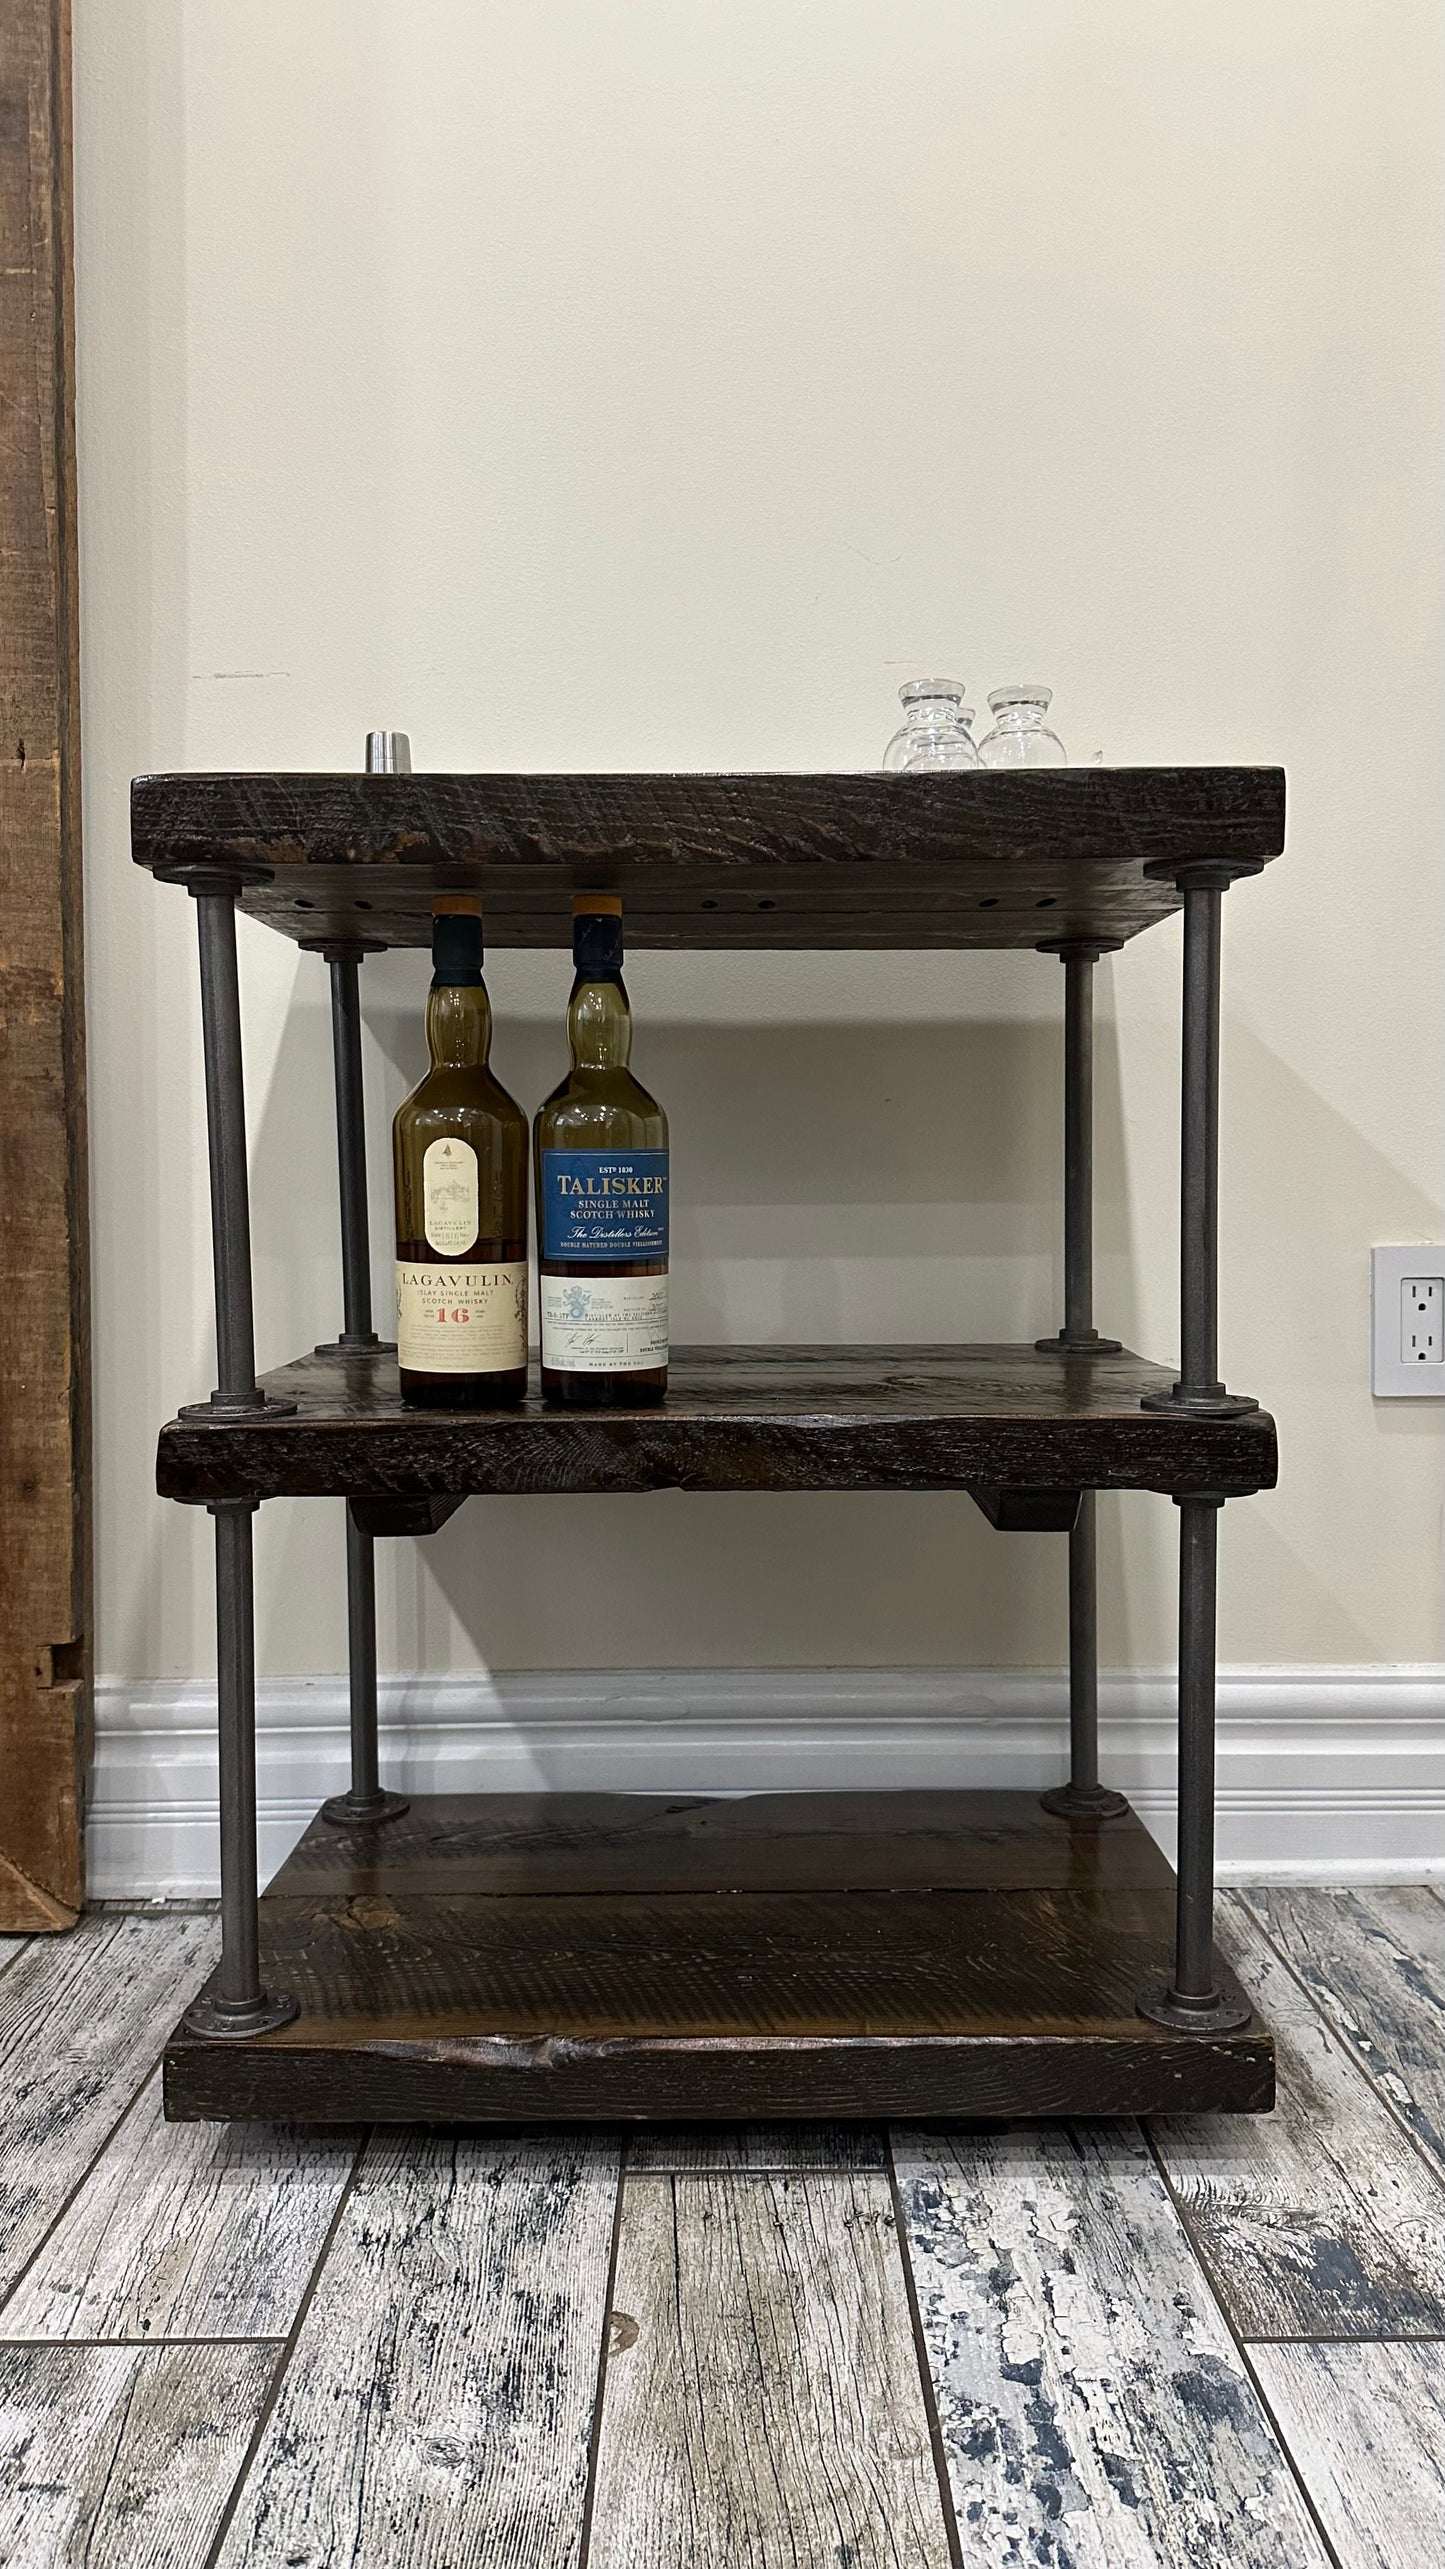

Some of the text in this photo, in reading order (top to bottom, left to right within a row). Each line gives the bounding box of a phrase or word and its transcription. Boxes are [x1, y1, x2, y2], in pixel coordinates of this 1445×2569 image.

[557, 1175, 664, 1195] TALISKER
[578, 1199, 650, 1209] SINGLE MALT
[570, 1209, 656, 1219] SCOTCH WHISKY
[567, 1224, 659, 1239] The Distillers Edition
[436, 1307, 470, 1323] 16
